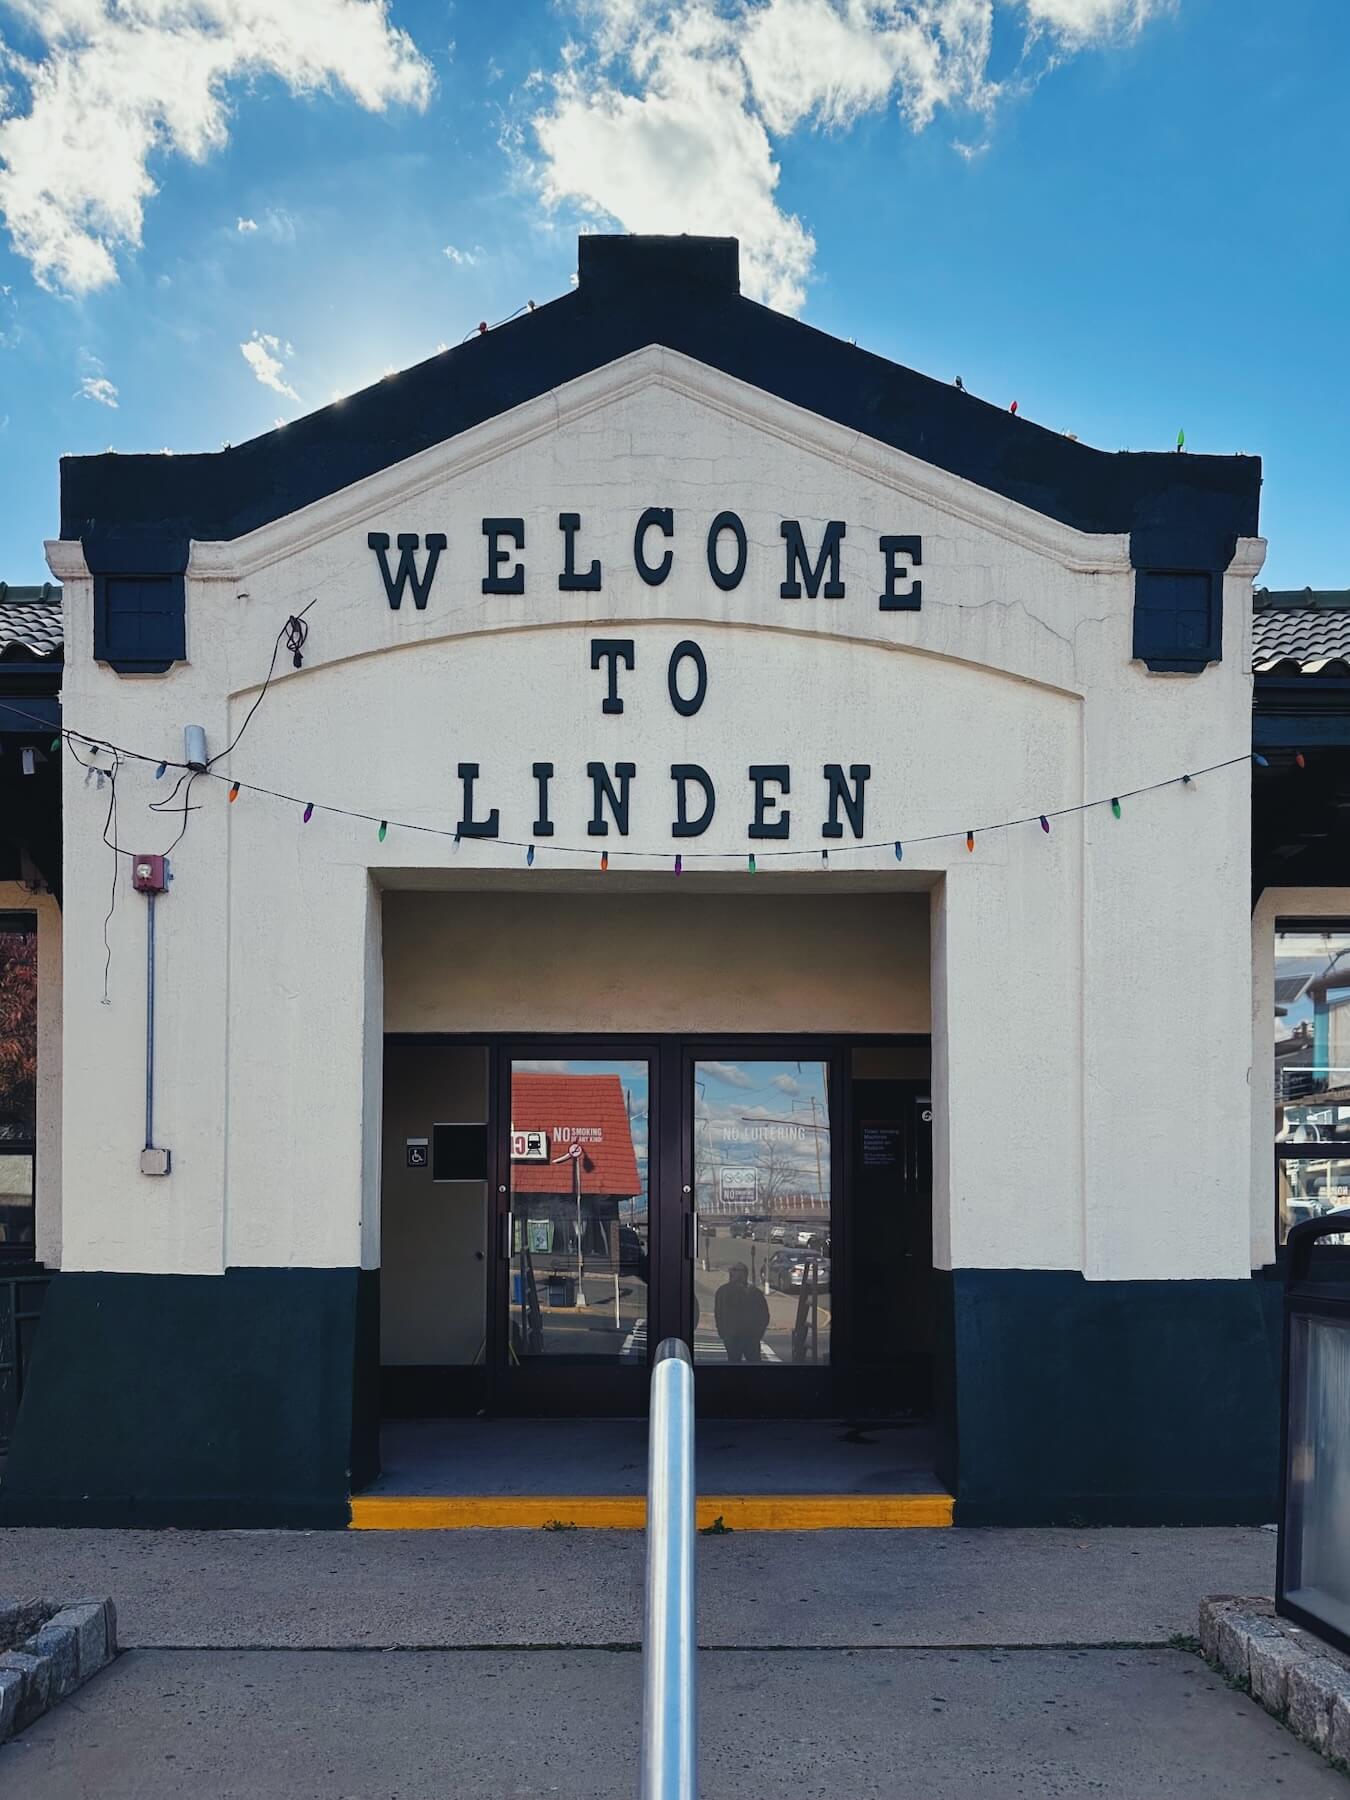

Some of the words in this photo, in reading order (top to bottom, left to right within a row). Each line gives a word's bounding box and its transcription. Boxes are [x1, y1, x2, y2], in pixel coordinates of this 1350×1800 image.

[367, 506, 922, 611] WELCOME
[590, 638, 708, 717] TO
[456, 761, 871, 840] LINDEN
[553, 1127, 570, 1142] NO
[571, 1127, 602, 1136] SMOKING
[723, 1127, 739, 1141] NO
[744, 1127, 806, 1141] LOITERING
[723, 1189, 735, 1200] NO
